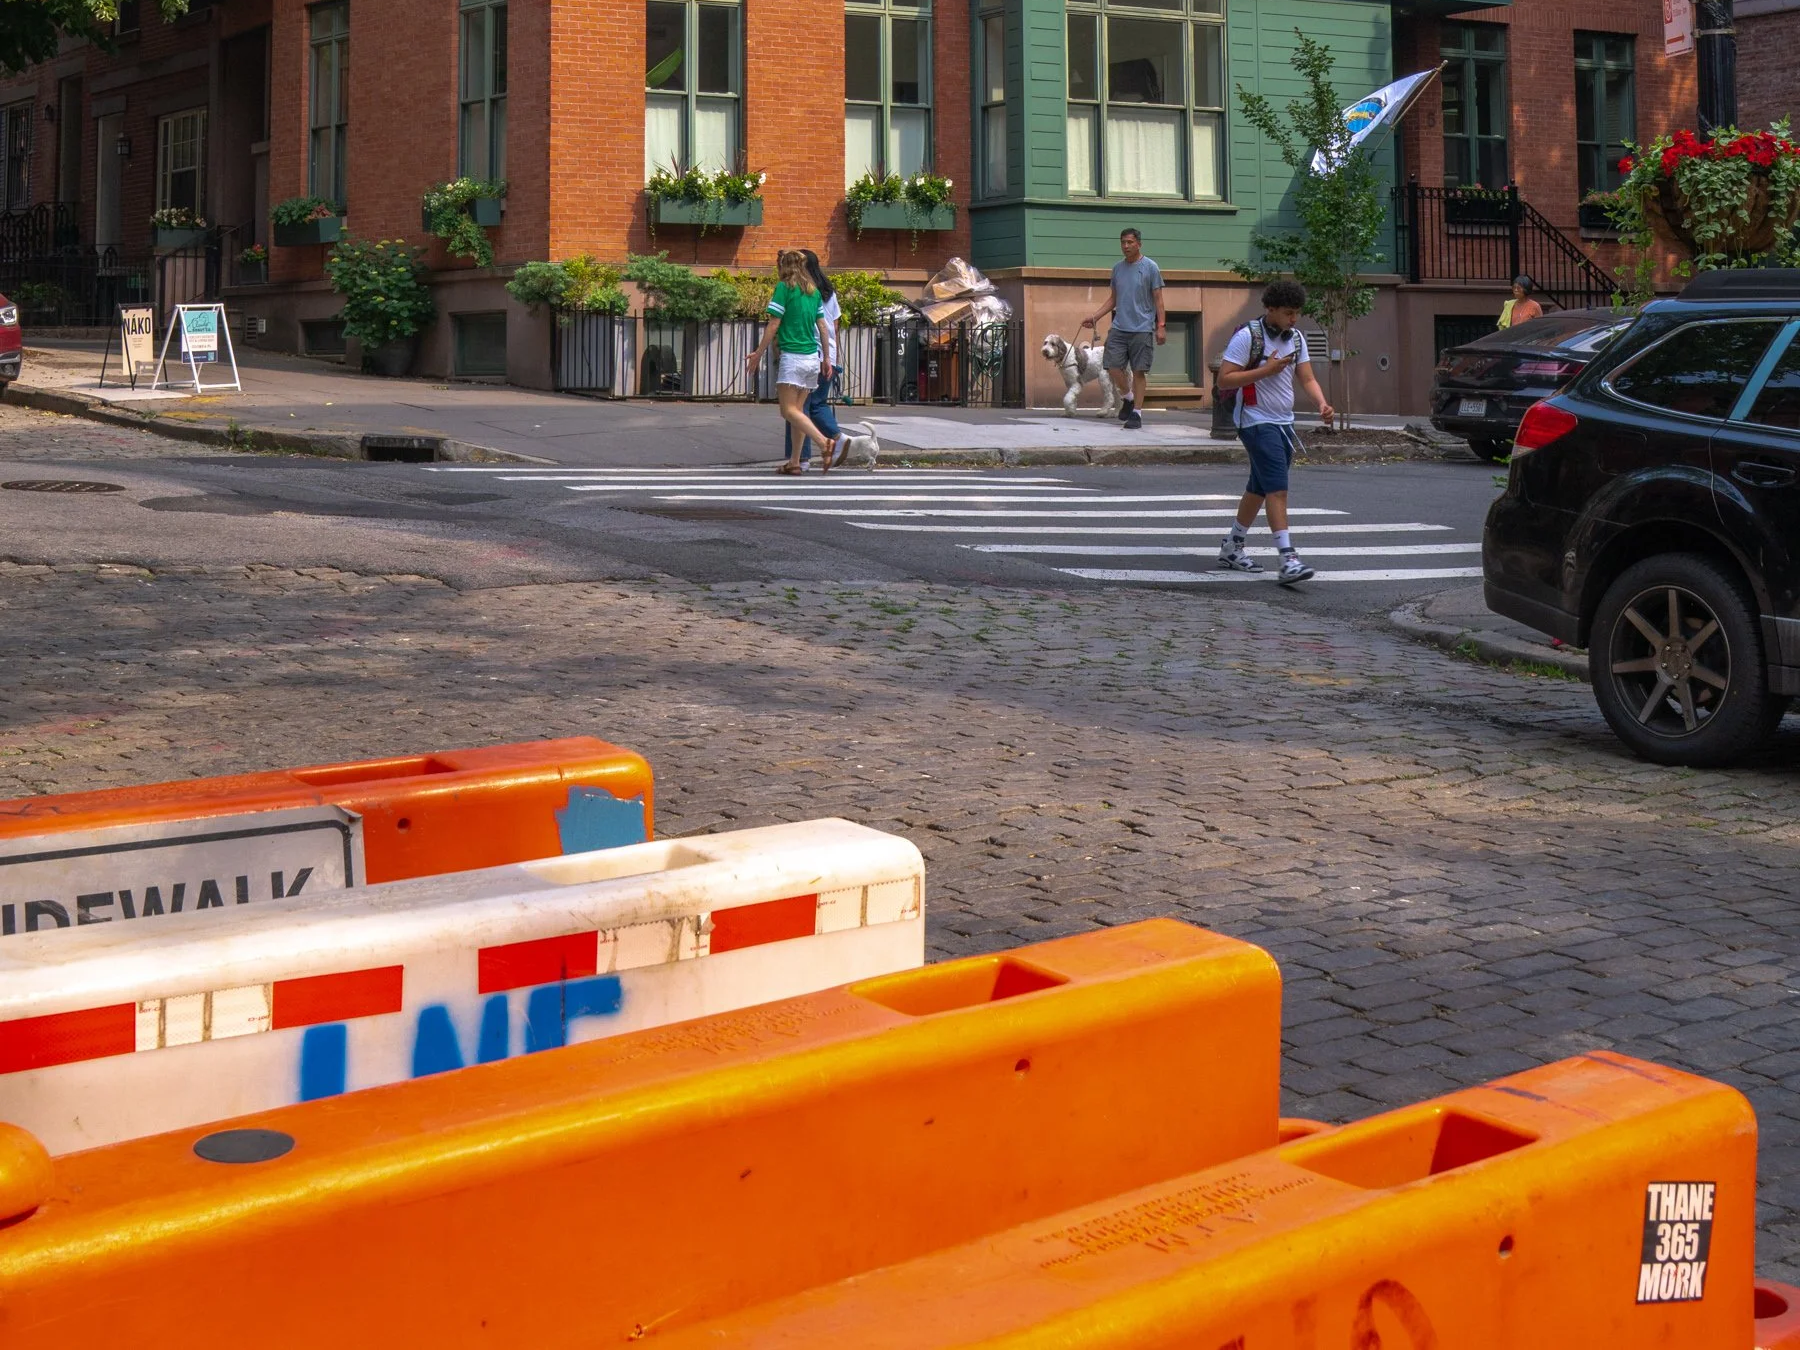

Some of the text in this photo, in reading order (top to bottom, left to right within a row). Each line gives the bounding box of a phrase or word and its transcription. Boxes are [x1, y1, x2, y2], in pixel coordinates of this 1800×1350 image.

[123, 314, 151, 336] NÁKO
[1647, 1183, 1715, 1221] THANE
[1655, 1222, 1700, 1262] 365
[1637, 1261, 1707, 1301] MORK
